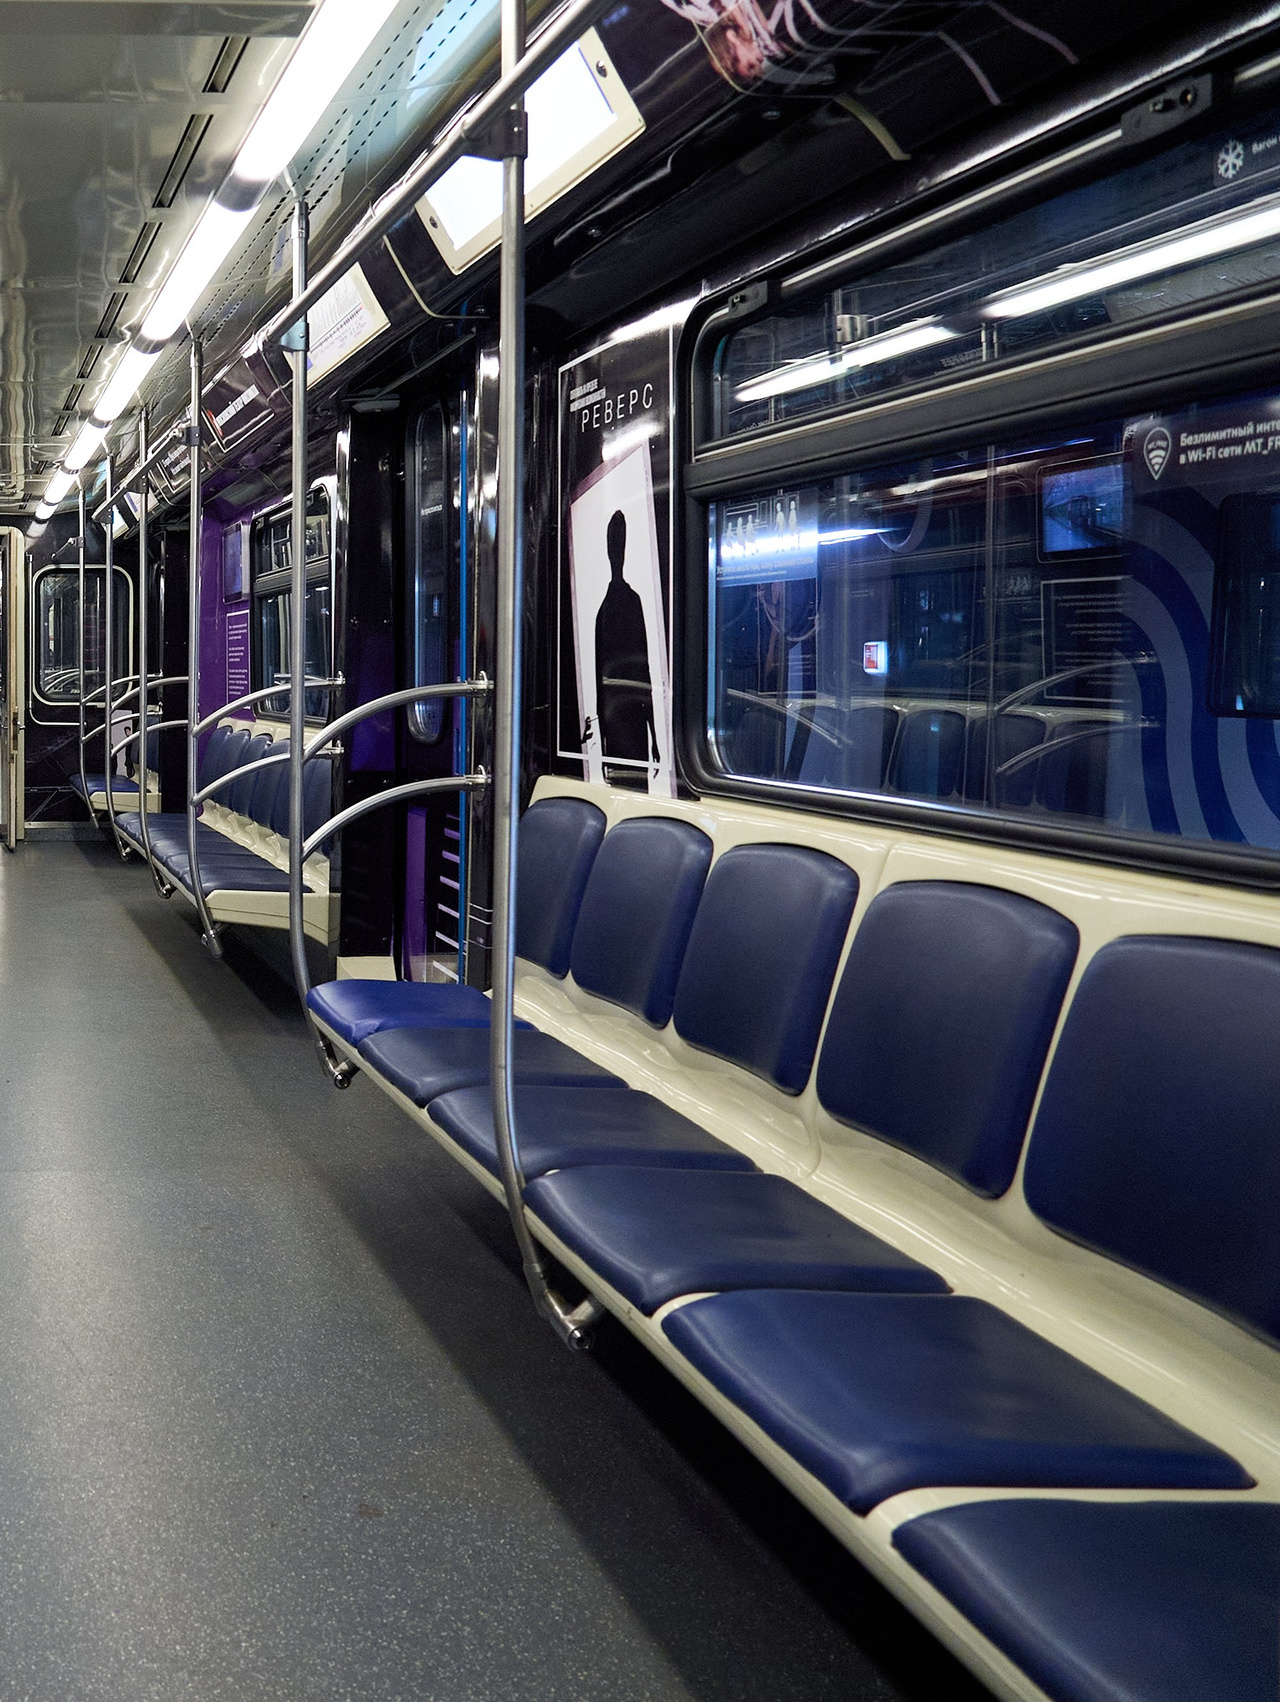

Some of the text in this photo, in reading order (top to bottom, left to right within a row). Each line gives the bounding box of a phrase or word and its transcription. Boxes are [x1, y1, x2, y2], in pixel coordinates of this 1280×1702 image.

[581, 382, 654, 433] РЕВЕРС
[1180, 421, 1255, 447] Безлимитный
[1179, 454, 1186, 465] в
[1187, 446, 1217, 463] Wi-Fi
[1217, 445, 1242, 459] сети
